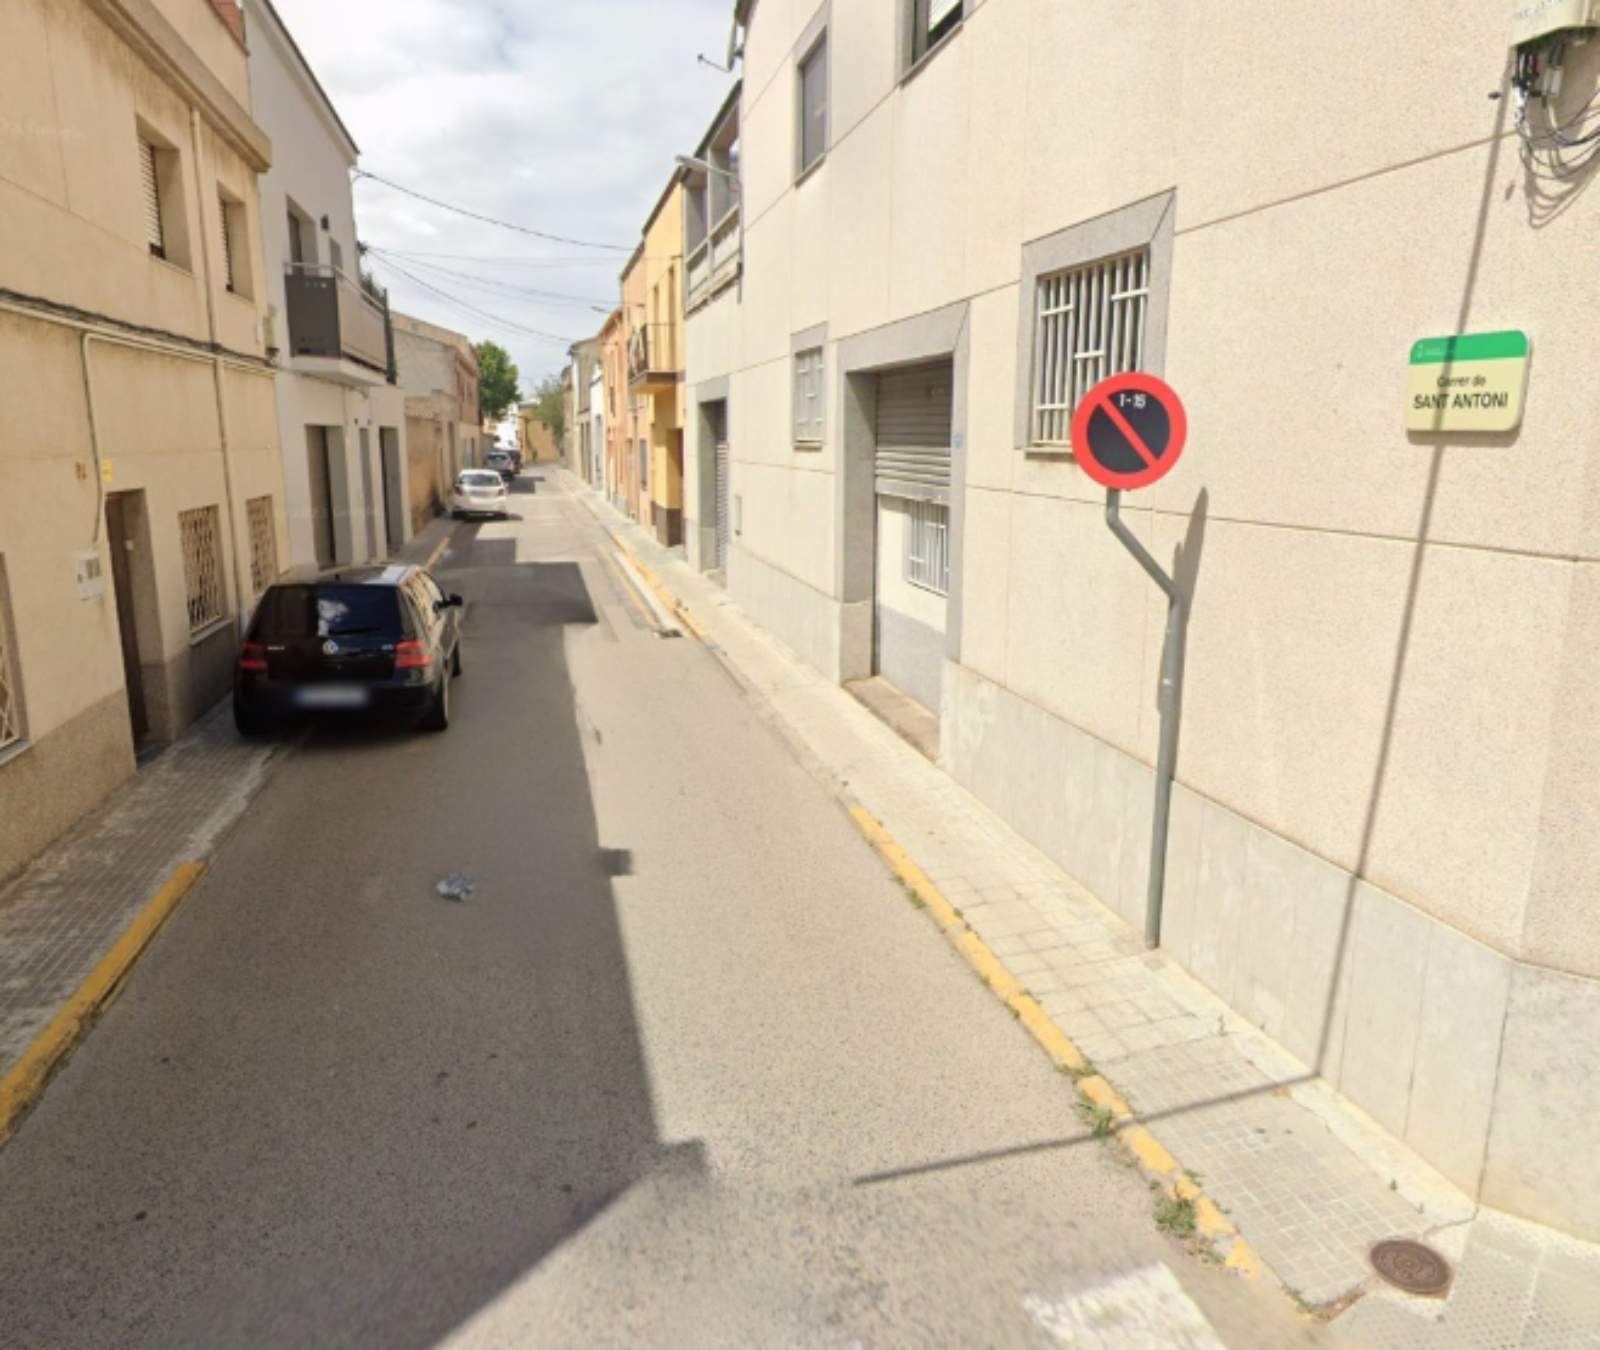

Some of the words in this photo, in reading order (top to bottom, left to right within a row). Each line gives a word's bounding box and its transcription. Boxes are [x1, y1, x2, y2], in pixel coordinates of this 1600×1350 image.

[1472, 375, 1487, 387] de
[1413, 393, 1449, 409] SANT
[1452, 392, 1509, 409] ANTONI
